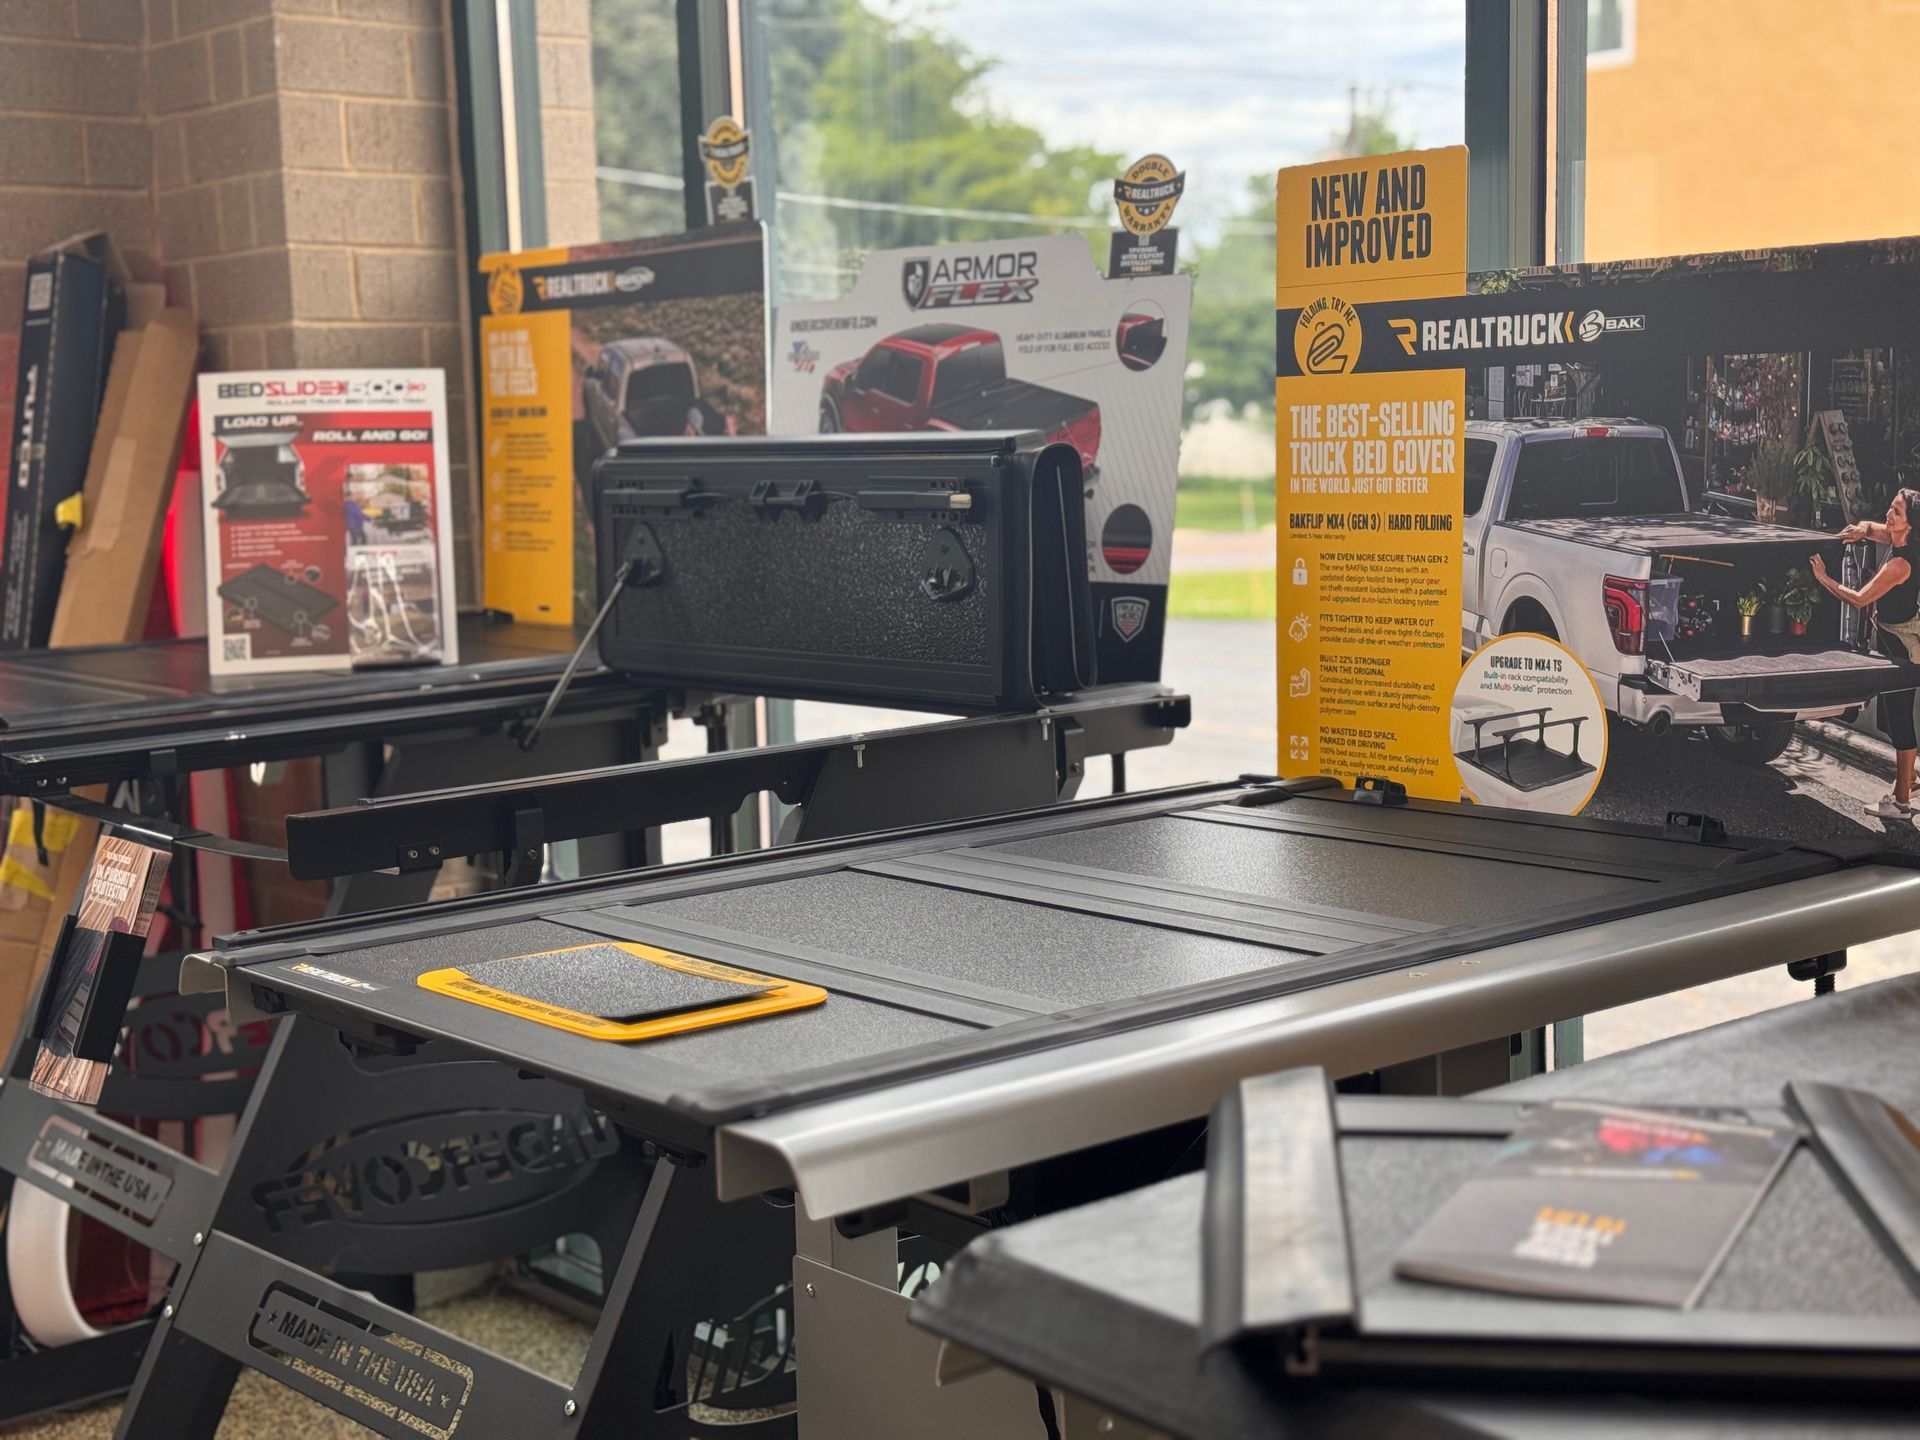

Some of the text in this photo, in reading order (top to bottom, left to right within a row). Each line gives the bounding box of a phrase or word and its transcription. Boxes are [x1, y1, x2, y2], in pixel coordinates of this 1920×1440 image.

[1132, 161, 1170, 180] DOUBLE
[1131, 183, 1175, 199] REALTRUCK
[1311, 164, 1426, 222] NEW AND
[1123, 203, 1170, 231] WARRANTY
[1305, 212, 1432, 268] IMPROVED
[932, 252, 1037, 282] ARMOR
[926, 278, 1036, 306] FLEX
[1331, 297, 1346, 313] TRY
[1343, 307, 1356, 327] ME
[1422, 312, 1641, 352] REALTRUCK BAK
[218, 380, 345, 399] BEDSLIDE
[222, 416, 269, 429] LOAD
[1290, 400, 1455, 439] THE BEST-SELLING
[313, 430, 428, 443] ROLL AND GO!
[1290, 439, 1455, 475] TRUCK BED COVER
[1290, 477, 1428, 494] IN THE WORLD JUST GOT BETTER
[1326, 513, 1345, 530] MX4
[1347, 512, 1369, 532] (GEN
[1370, 512, 1381, 532] 3)
[1388, 514, 1412, 531] HARD
[1414, 514, 1453, 531] FOLDING
[1320, 614, 1334, 622] FITS
[1335, 615, 1363, 623] TIGHTER
[1394, 617, 1418, 626] WATER
[1320, 655, 1390, 666] BUILT 22% STRONGER
[1490, 656, 1562, 672] UPGRADE TO MX4 TS
[1320, 666, 1337, 674] THAN
[1354, 668, 1385, 676] ORIGINAL
[1484, 671, 1568, 685] Built-in rack compatability
[1480, 682, 1492, 690] and
[1537, 687, 1572, 695] protection
[1331, 728, 1356, 736] WASTED
[1359, 730, 1372, 738] BED
[1320, 737, 1385, 750] PARKED OR DRIVING
[50, 1138, 153, 1201] MADE IN THE USA
[277, 1311, 437, 1407] MADE IN THE USA
